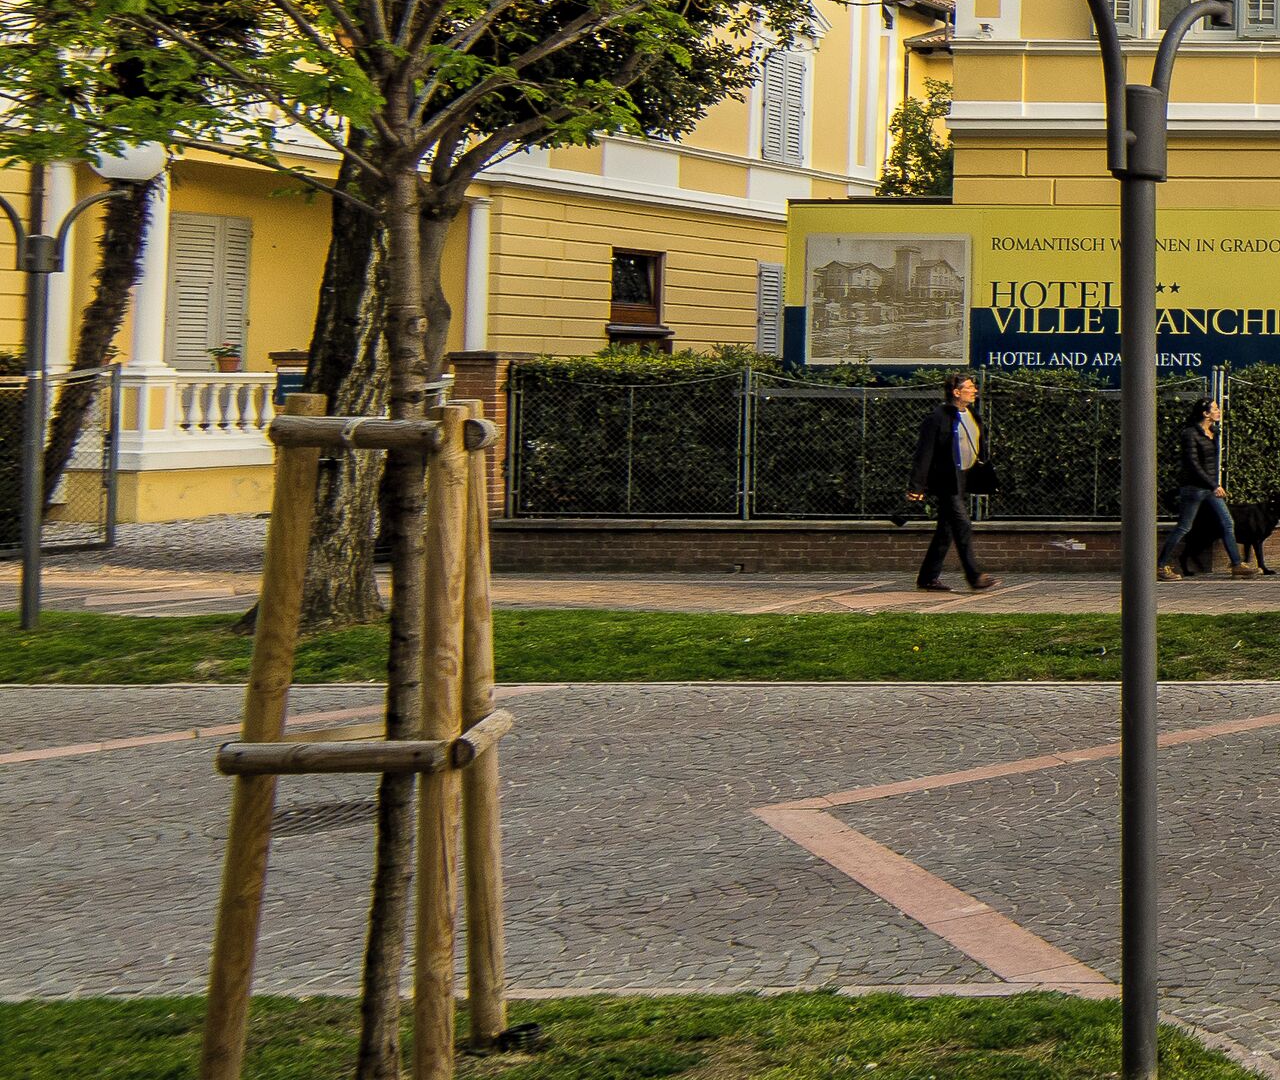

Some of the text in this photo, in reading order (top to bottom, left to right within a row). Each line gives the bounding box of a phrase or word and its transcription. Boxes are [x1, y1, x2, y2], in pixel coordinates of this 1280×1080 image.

[991, 237, 1105, 251] ROMANTISCH
[1110, 238, 1191, 252] WNEN
[1196, 239, 1215, 252] IN
[989, 280, 1122, 308] HOTEL
[990, 307, 1105, 334] VILLE
[988, 352, 1046, 366] HOTEL
[1048, 352, 1088, 366] AND
